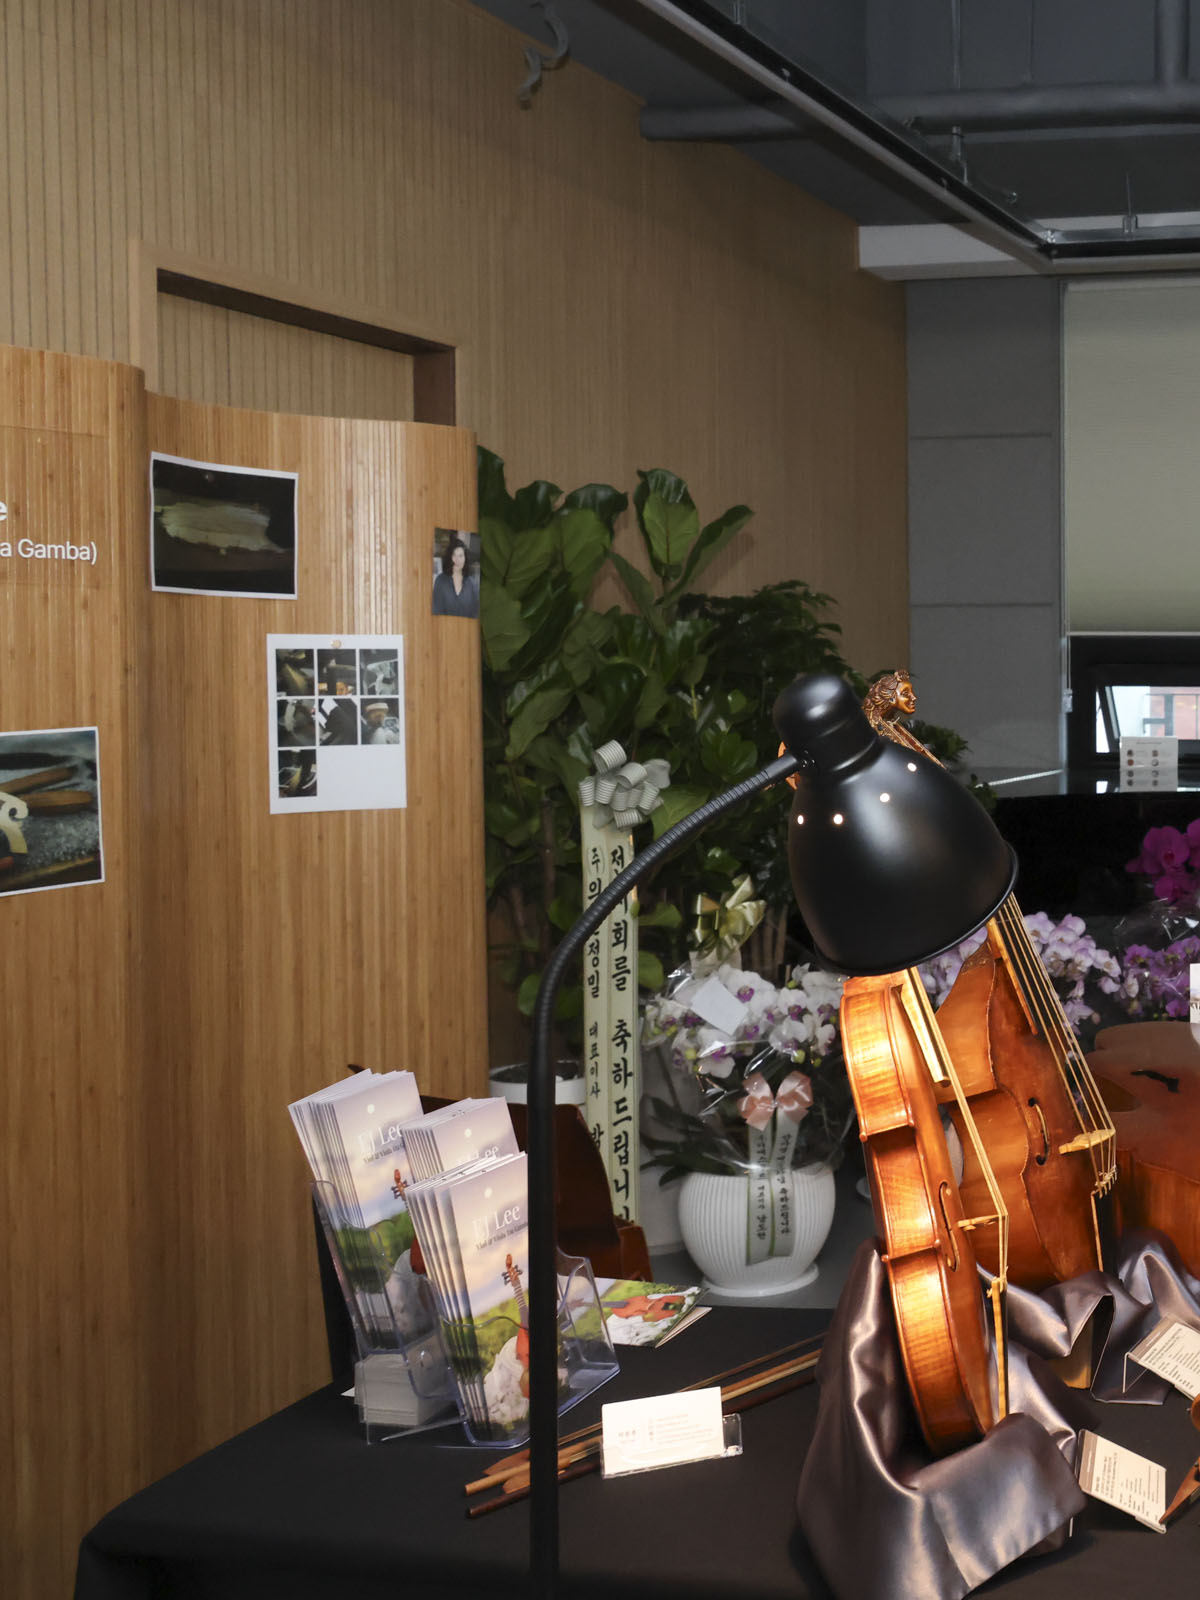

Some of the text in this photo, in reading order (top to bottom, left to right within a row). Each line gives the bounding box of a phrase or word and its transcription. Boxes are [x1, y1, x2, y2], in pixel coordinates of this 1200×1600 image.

[17, 538, 97, 566] Gamba)
[610, 844, 632, 993] 전회를
[588, 1022, 601, 1099] 대표이사
[494, 1205, 521, 1230] Lee
